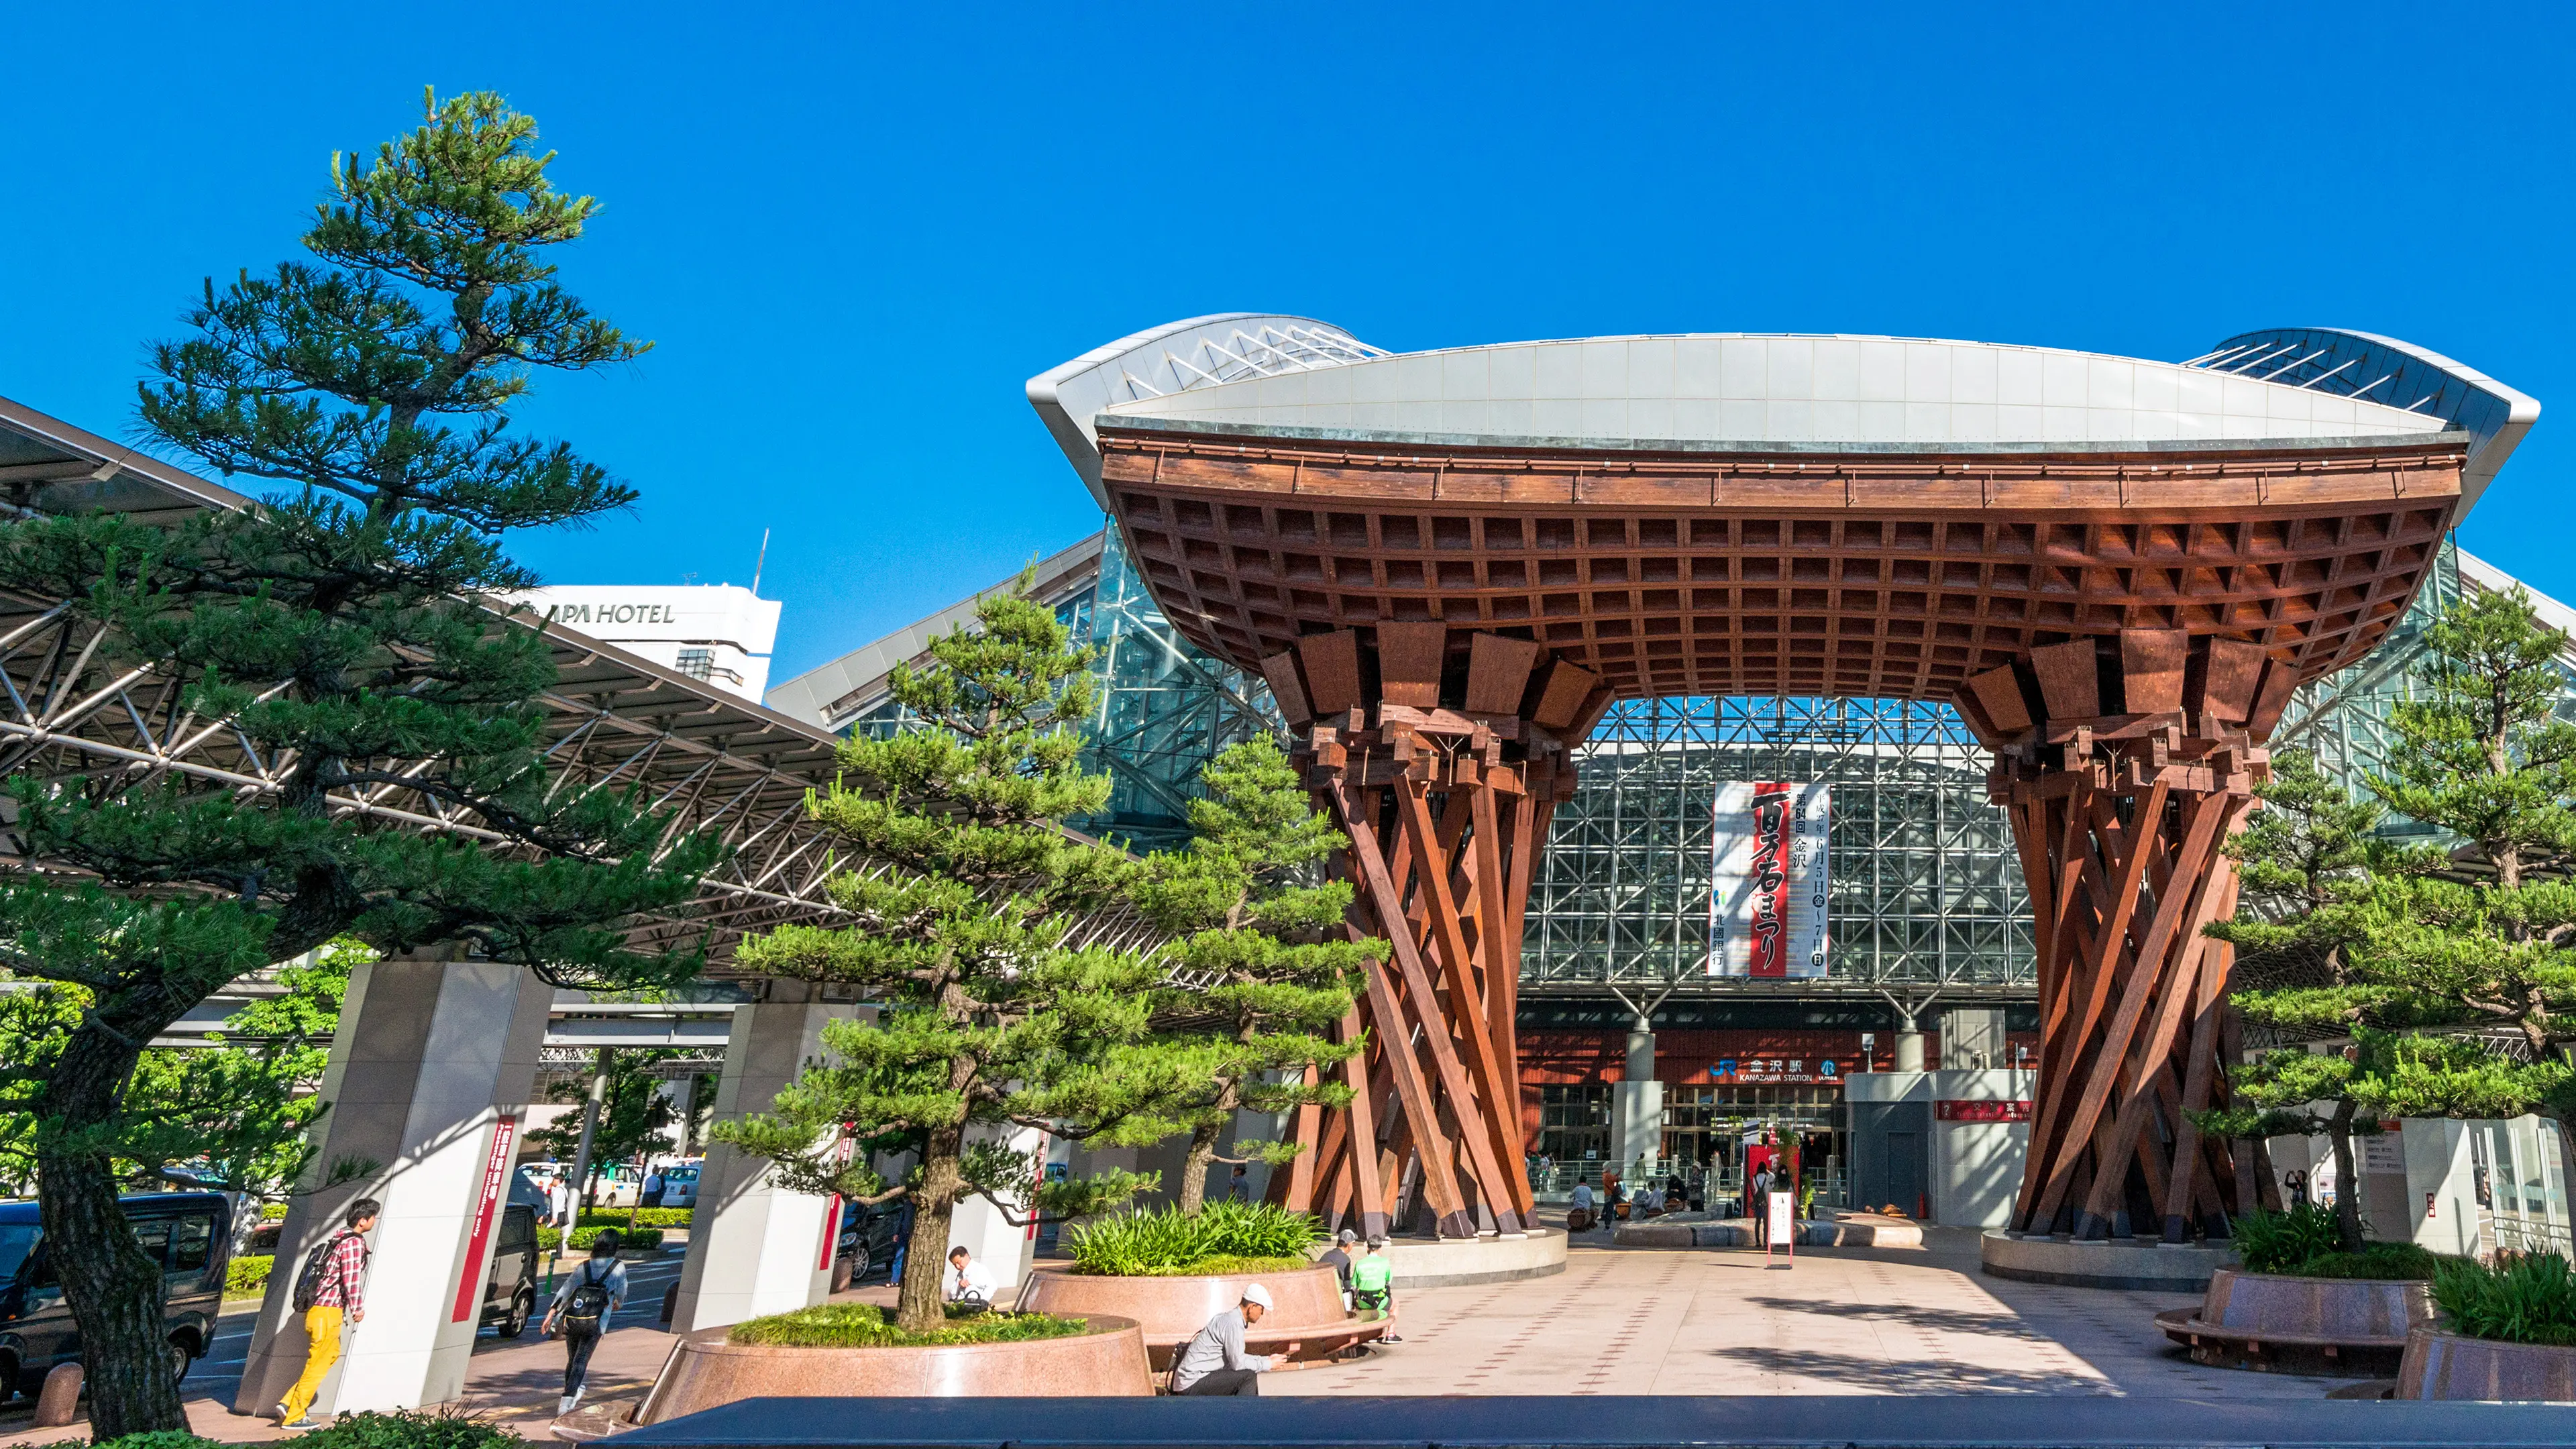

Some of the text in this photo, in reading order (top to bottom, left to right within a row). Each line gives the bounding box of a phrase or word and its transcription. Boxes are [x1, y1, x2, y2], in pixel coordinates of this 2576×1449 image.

[596, 604, 676, 623] HOTEL
[1793, 793, 1807, 868] 第64回 金沢
[1747, 792, 1790, 970] 百万石まつり
[1709, 1059, 1737, 1076] JR
[1750, 1059, 1803, 1072] 金沢駅
[478, 1172, 492, 1216] unloading
[473, 1218, 482, 1237] only
